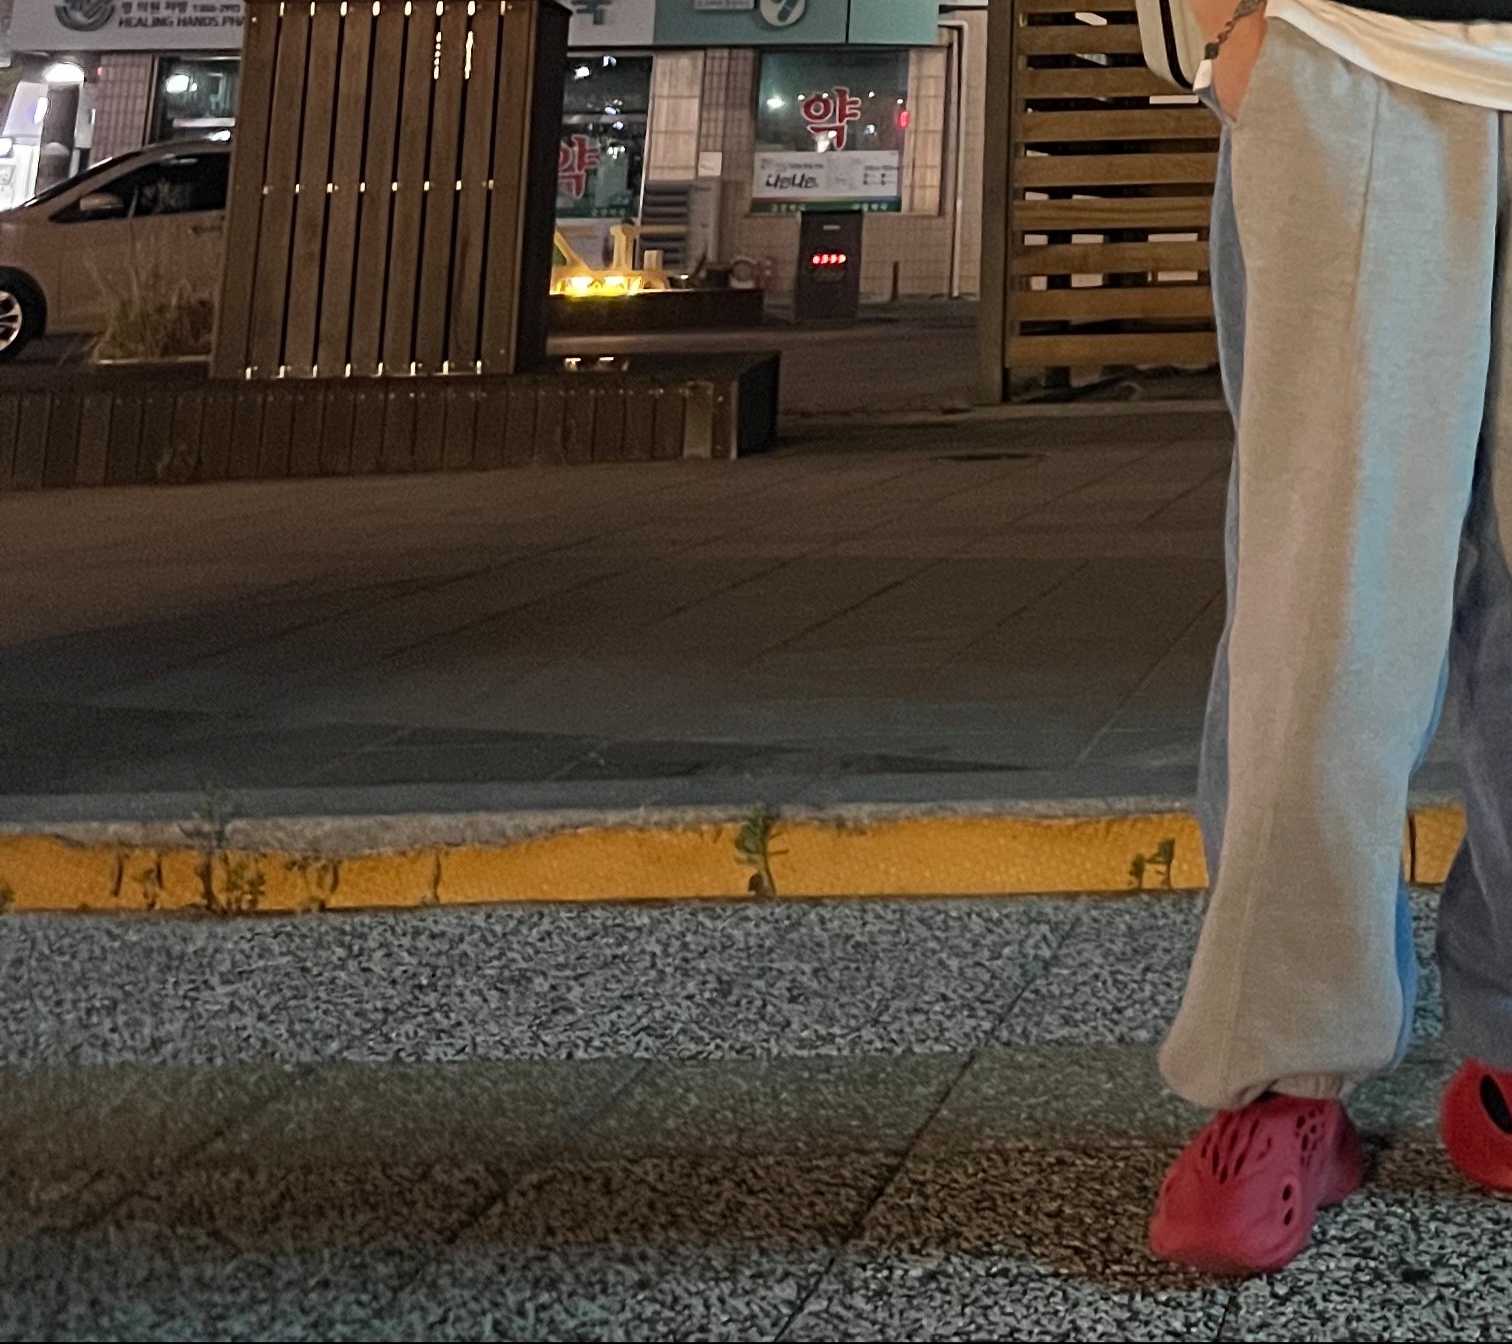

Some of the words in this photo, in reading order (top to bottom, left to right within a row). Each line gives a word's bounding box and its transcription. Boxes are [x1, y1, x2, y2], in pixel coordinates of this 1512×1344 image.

[118, 16, 174, 28] HEALING
[176, 15, 219, 27] HANDS
[801, 86, 862, 151] 약
